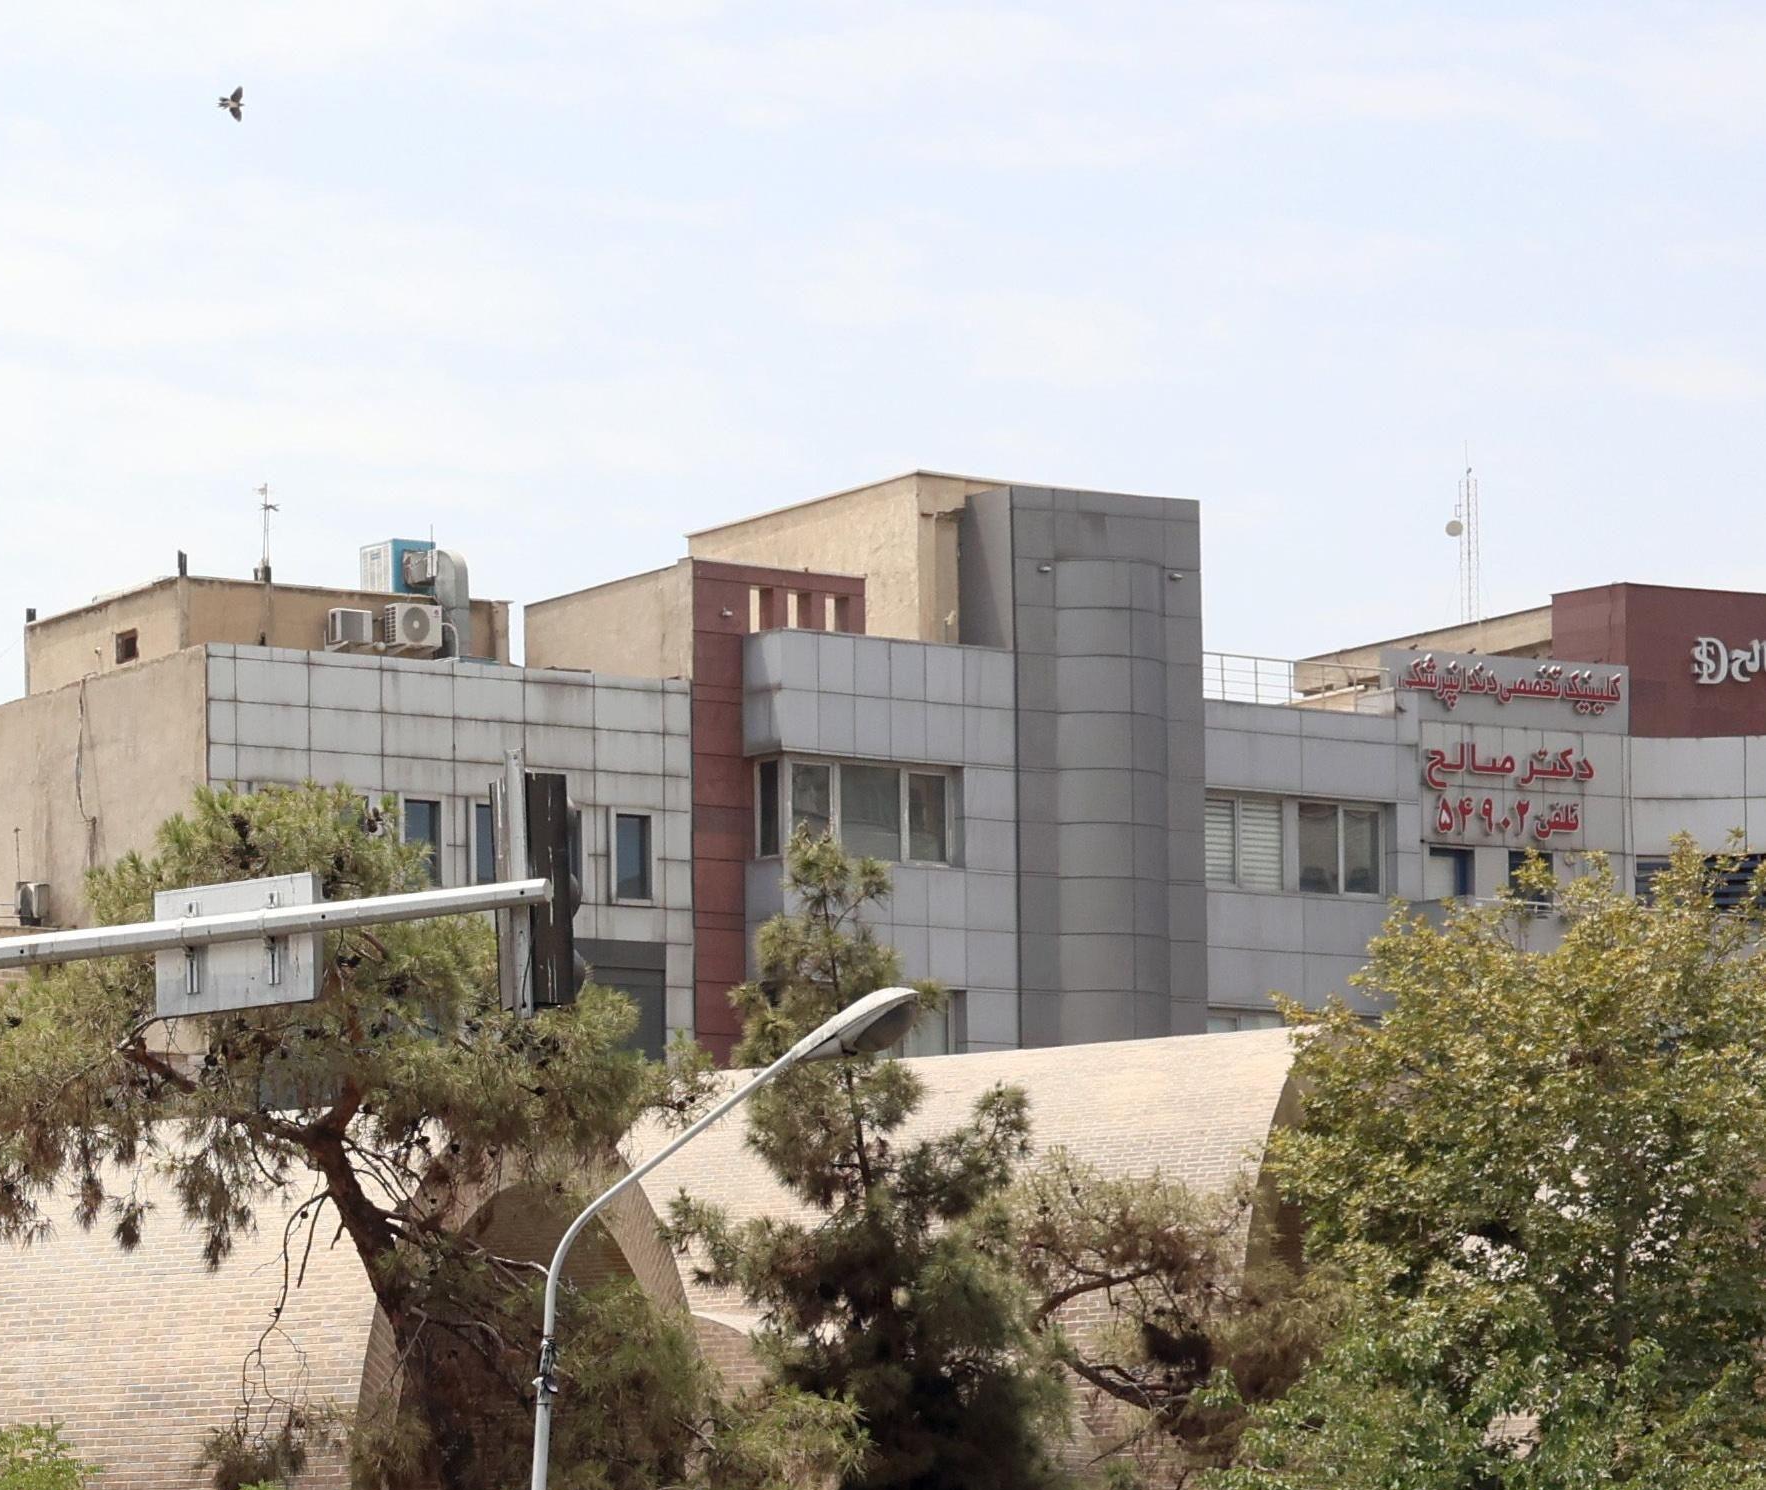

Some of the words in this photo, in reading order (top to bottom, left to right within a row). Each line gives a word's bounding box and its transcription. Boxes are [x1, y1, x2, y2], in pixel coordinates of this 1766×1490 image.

[1427, 743, 1516, 789] صالح
[1520, 748, 1594, 785] دکتر
[1535, 803, 1580, 839] تلفن
